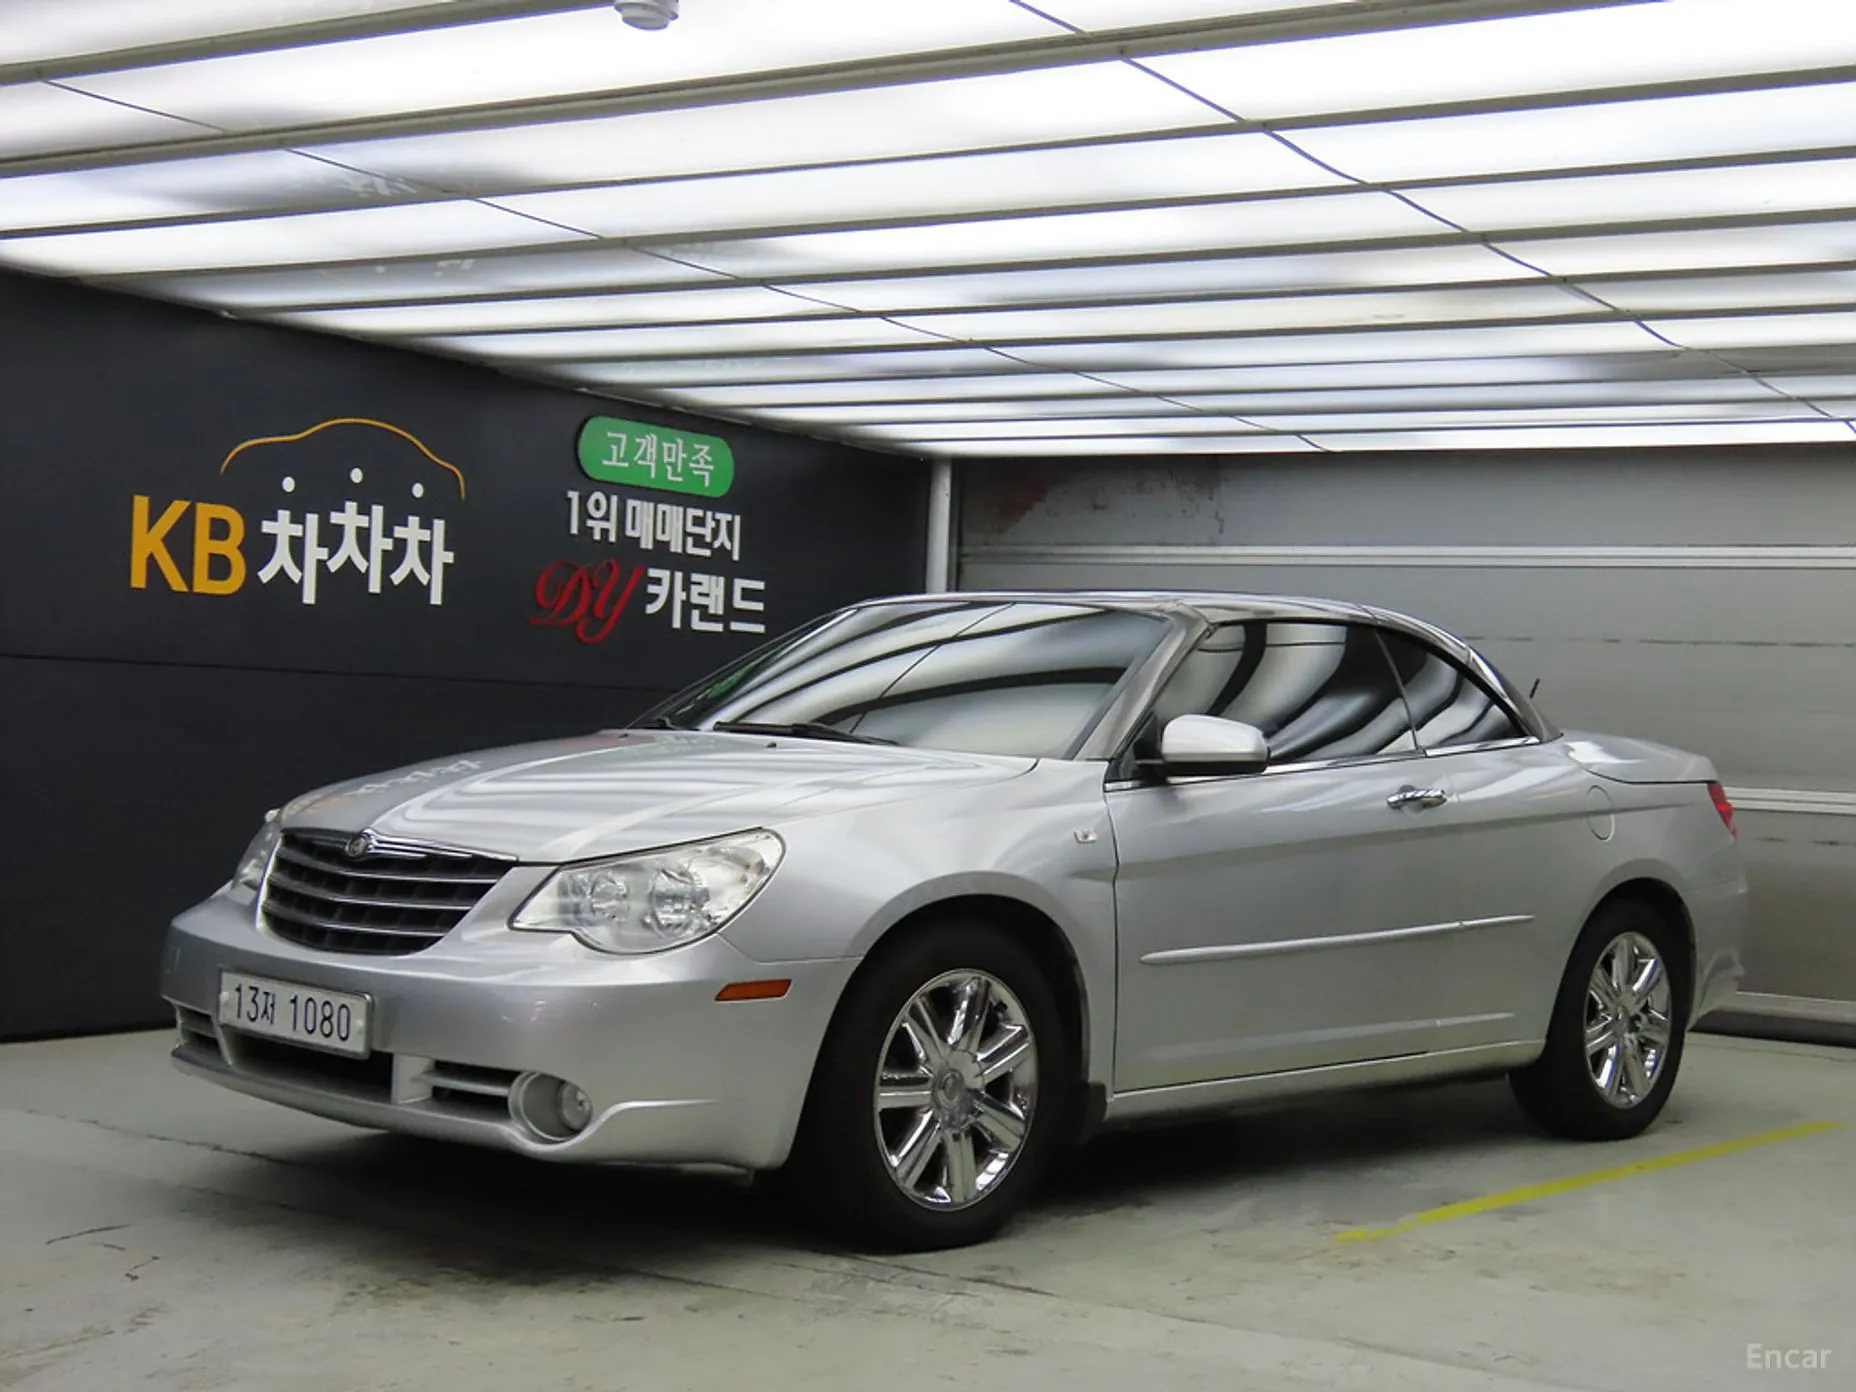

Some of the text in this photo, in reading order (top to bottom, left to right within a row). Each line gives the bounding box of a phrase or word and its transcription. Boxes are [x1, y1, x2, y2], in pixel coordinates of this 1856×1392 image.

[602, 432, 714, 487] 고객만족
[567, 490, 741, 562] 1위 매매단지
[645, 567, 767, 633] 카랜드
[290, 994, 351, 1042] 1080
